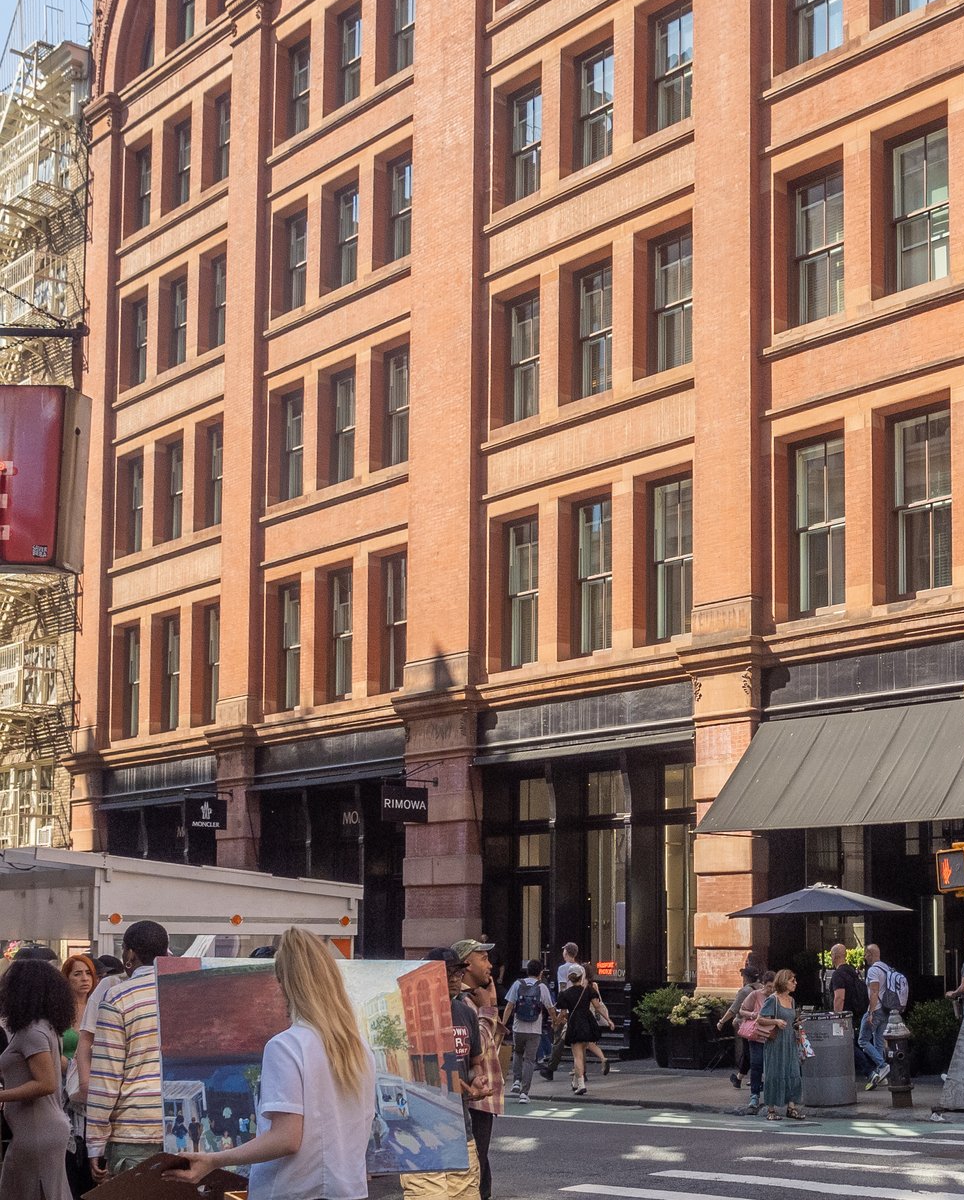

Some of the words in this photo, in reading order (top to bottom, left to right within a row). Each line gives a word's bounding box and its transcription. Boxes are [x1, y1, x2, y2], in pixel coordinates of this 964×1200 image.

[384, 798, 426, 810] RIMOWA
[342, 810, 360, 825] MO
[176, 826, 185, 838] M
[453, 1028, 467, 1036] OWN
